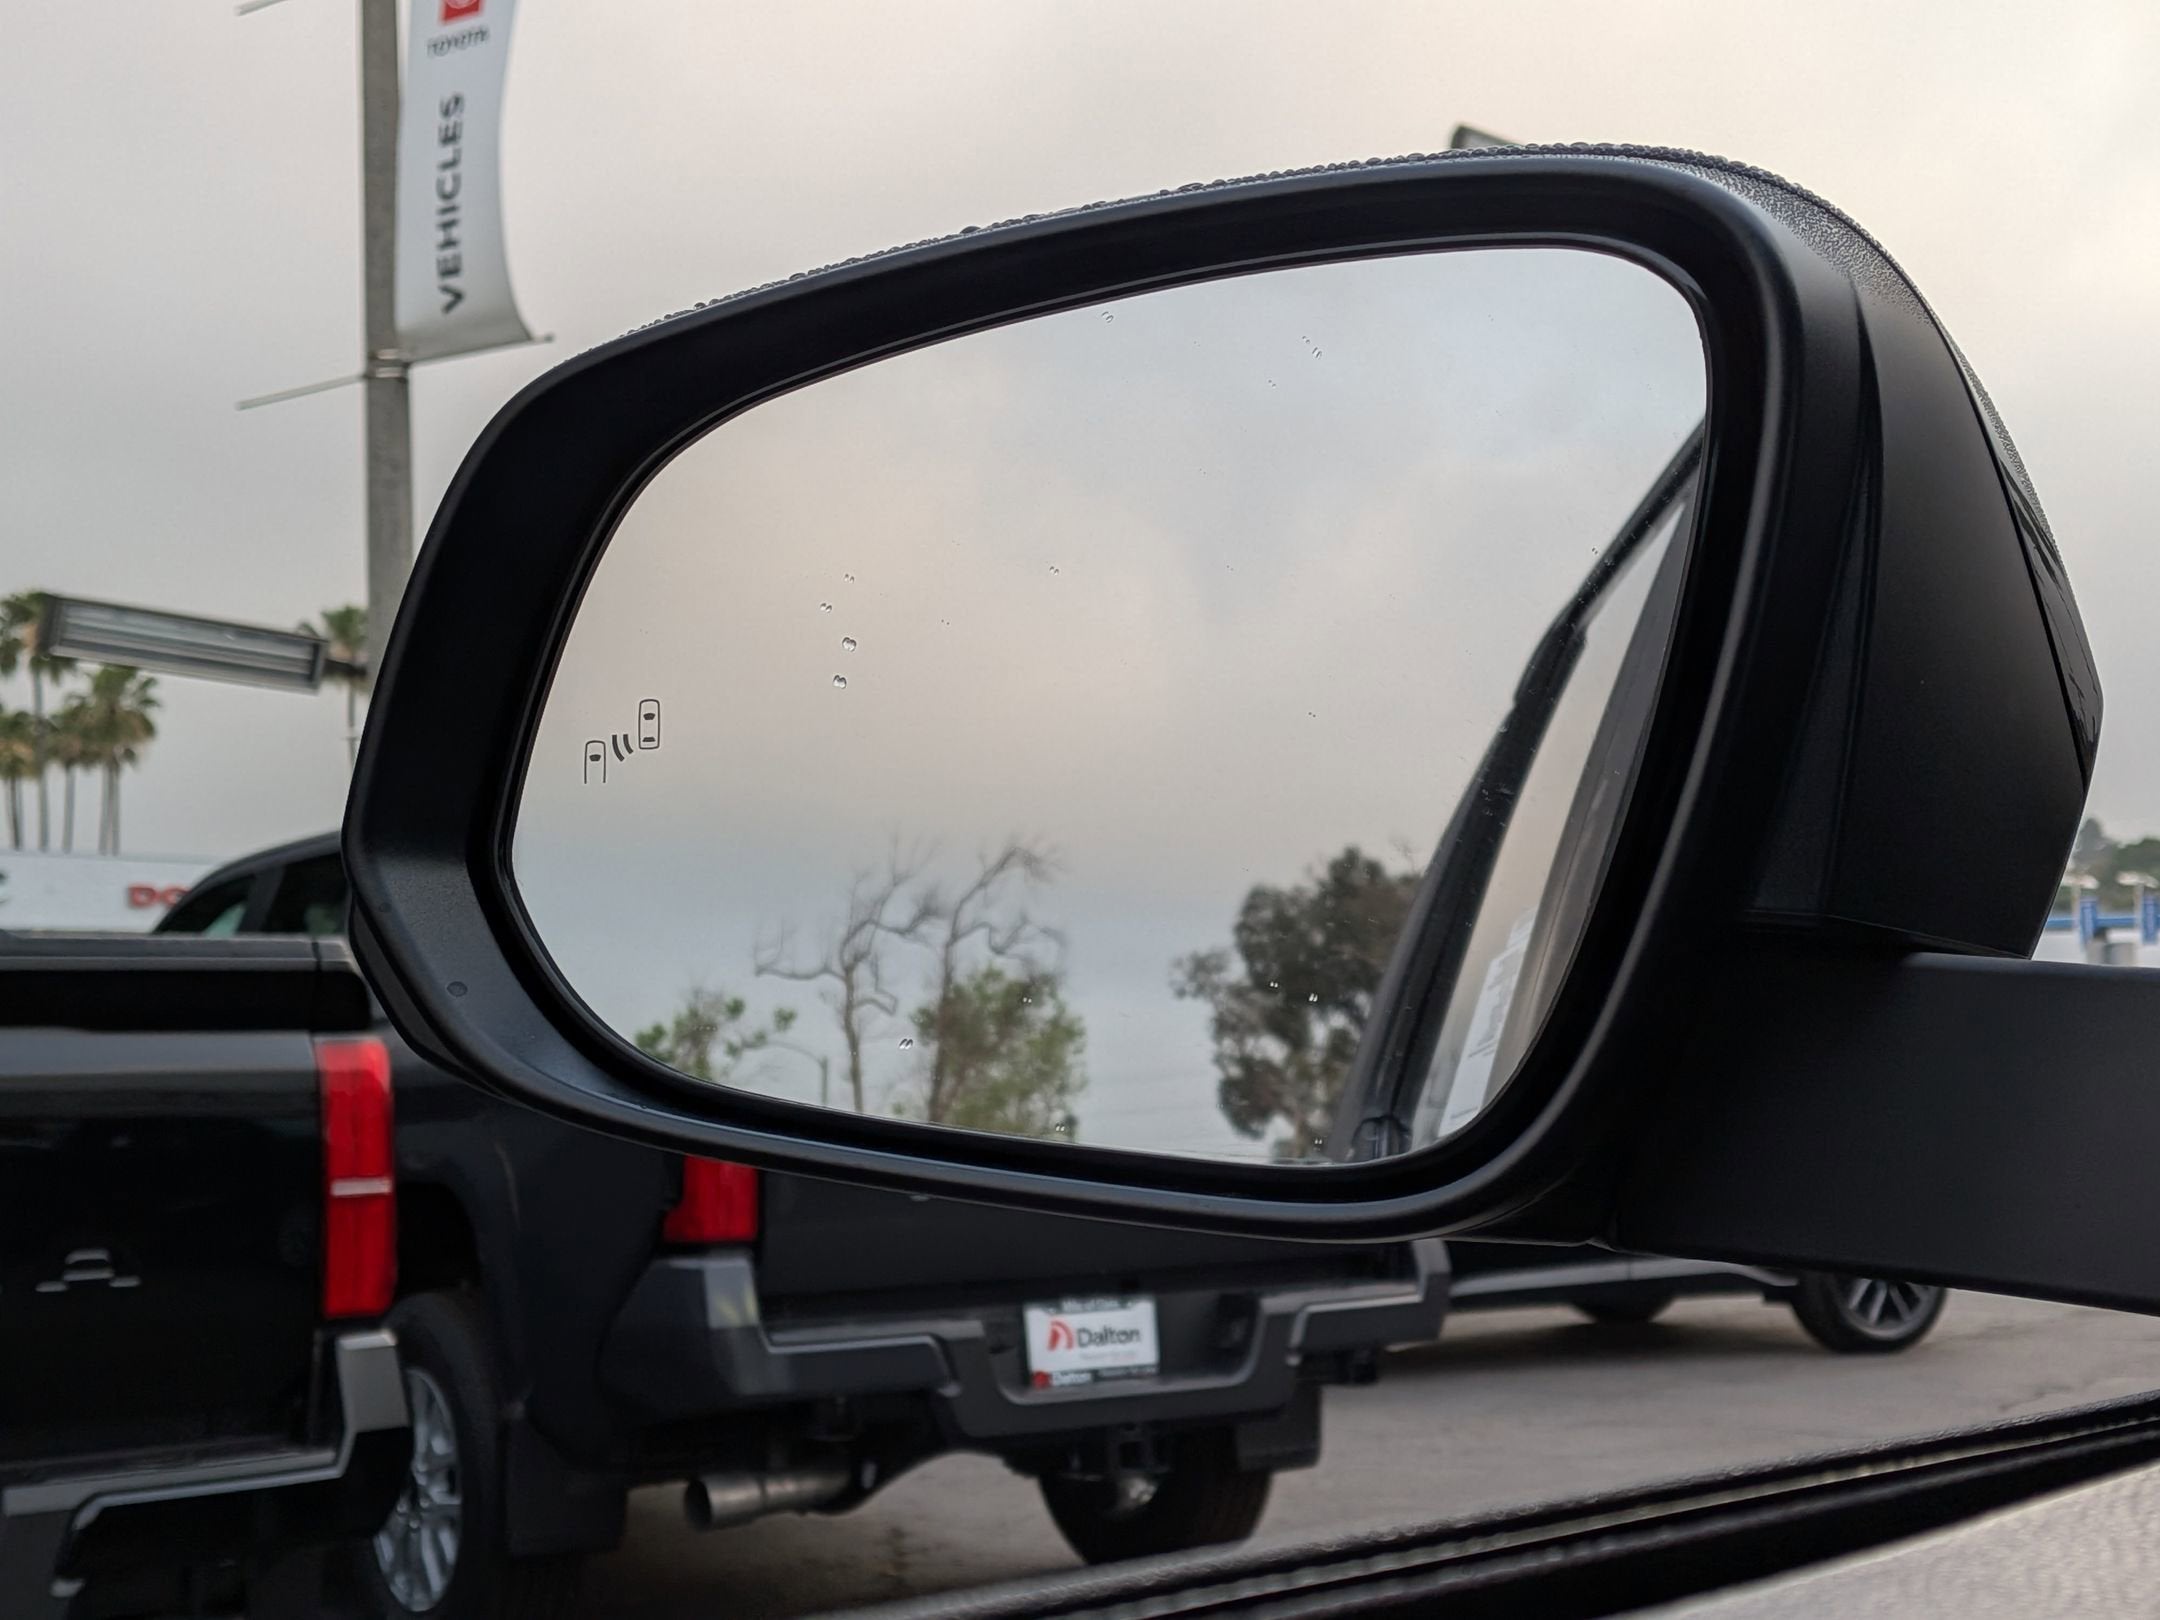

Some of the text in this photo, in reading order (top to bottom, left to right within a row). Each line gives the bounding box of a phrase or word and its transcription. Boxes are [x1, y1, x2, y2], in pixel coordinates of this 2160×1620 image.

[427, 26, 491, 57] TOYOTA
[436, 93, 465, 314] VEHICLES
[1076, 1325, 1140, 1348] Dalton
